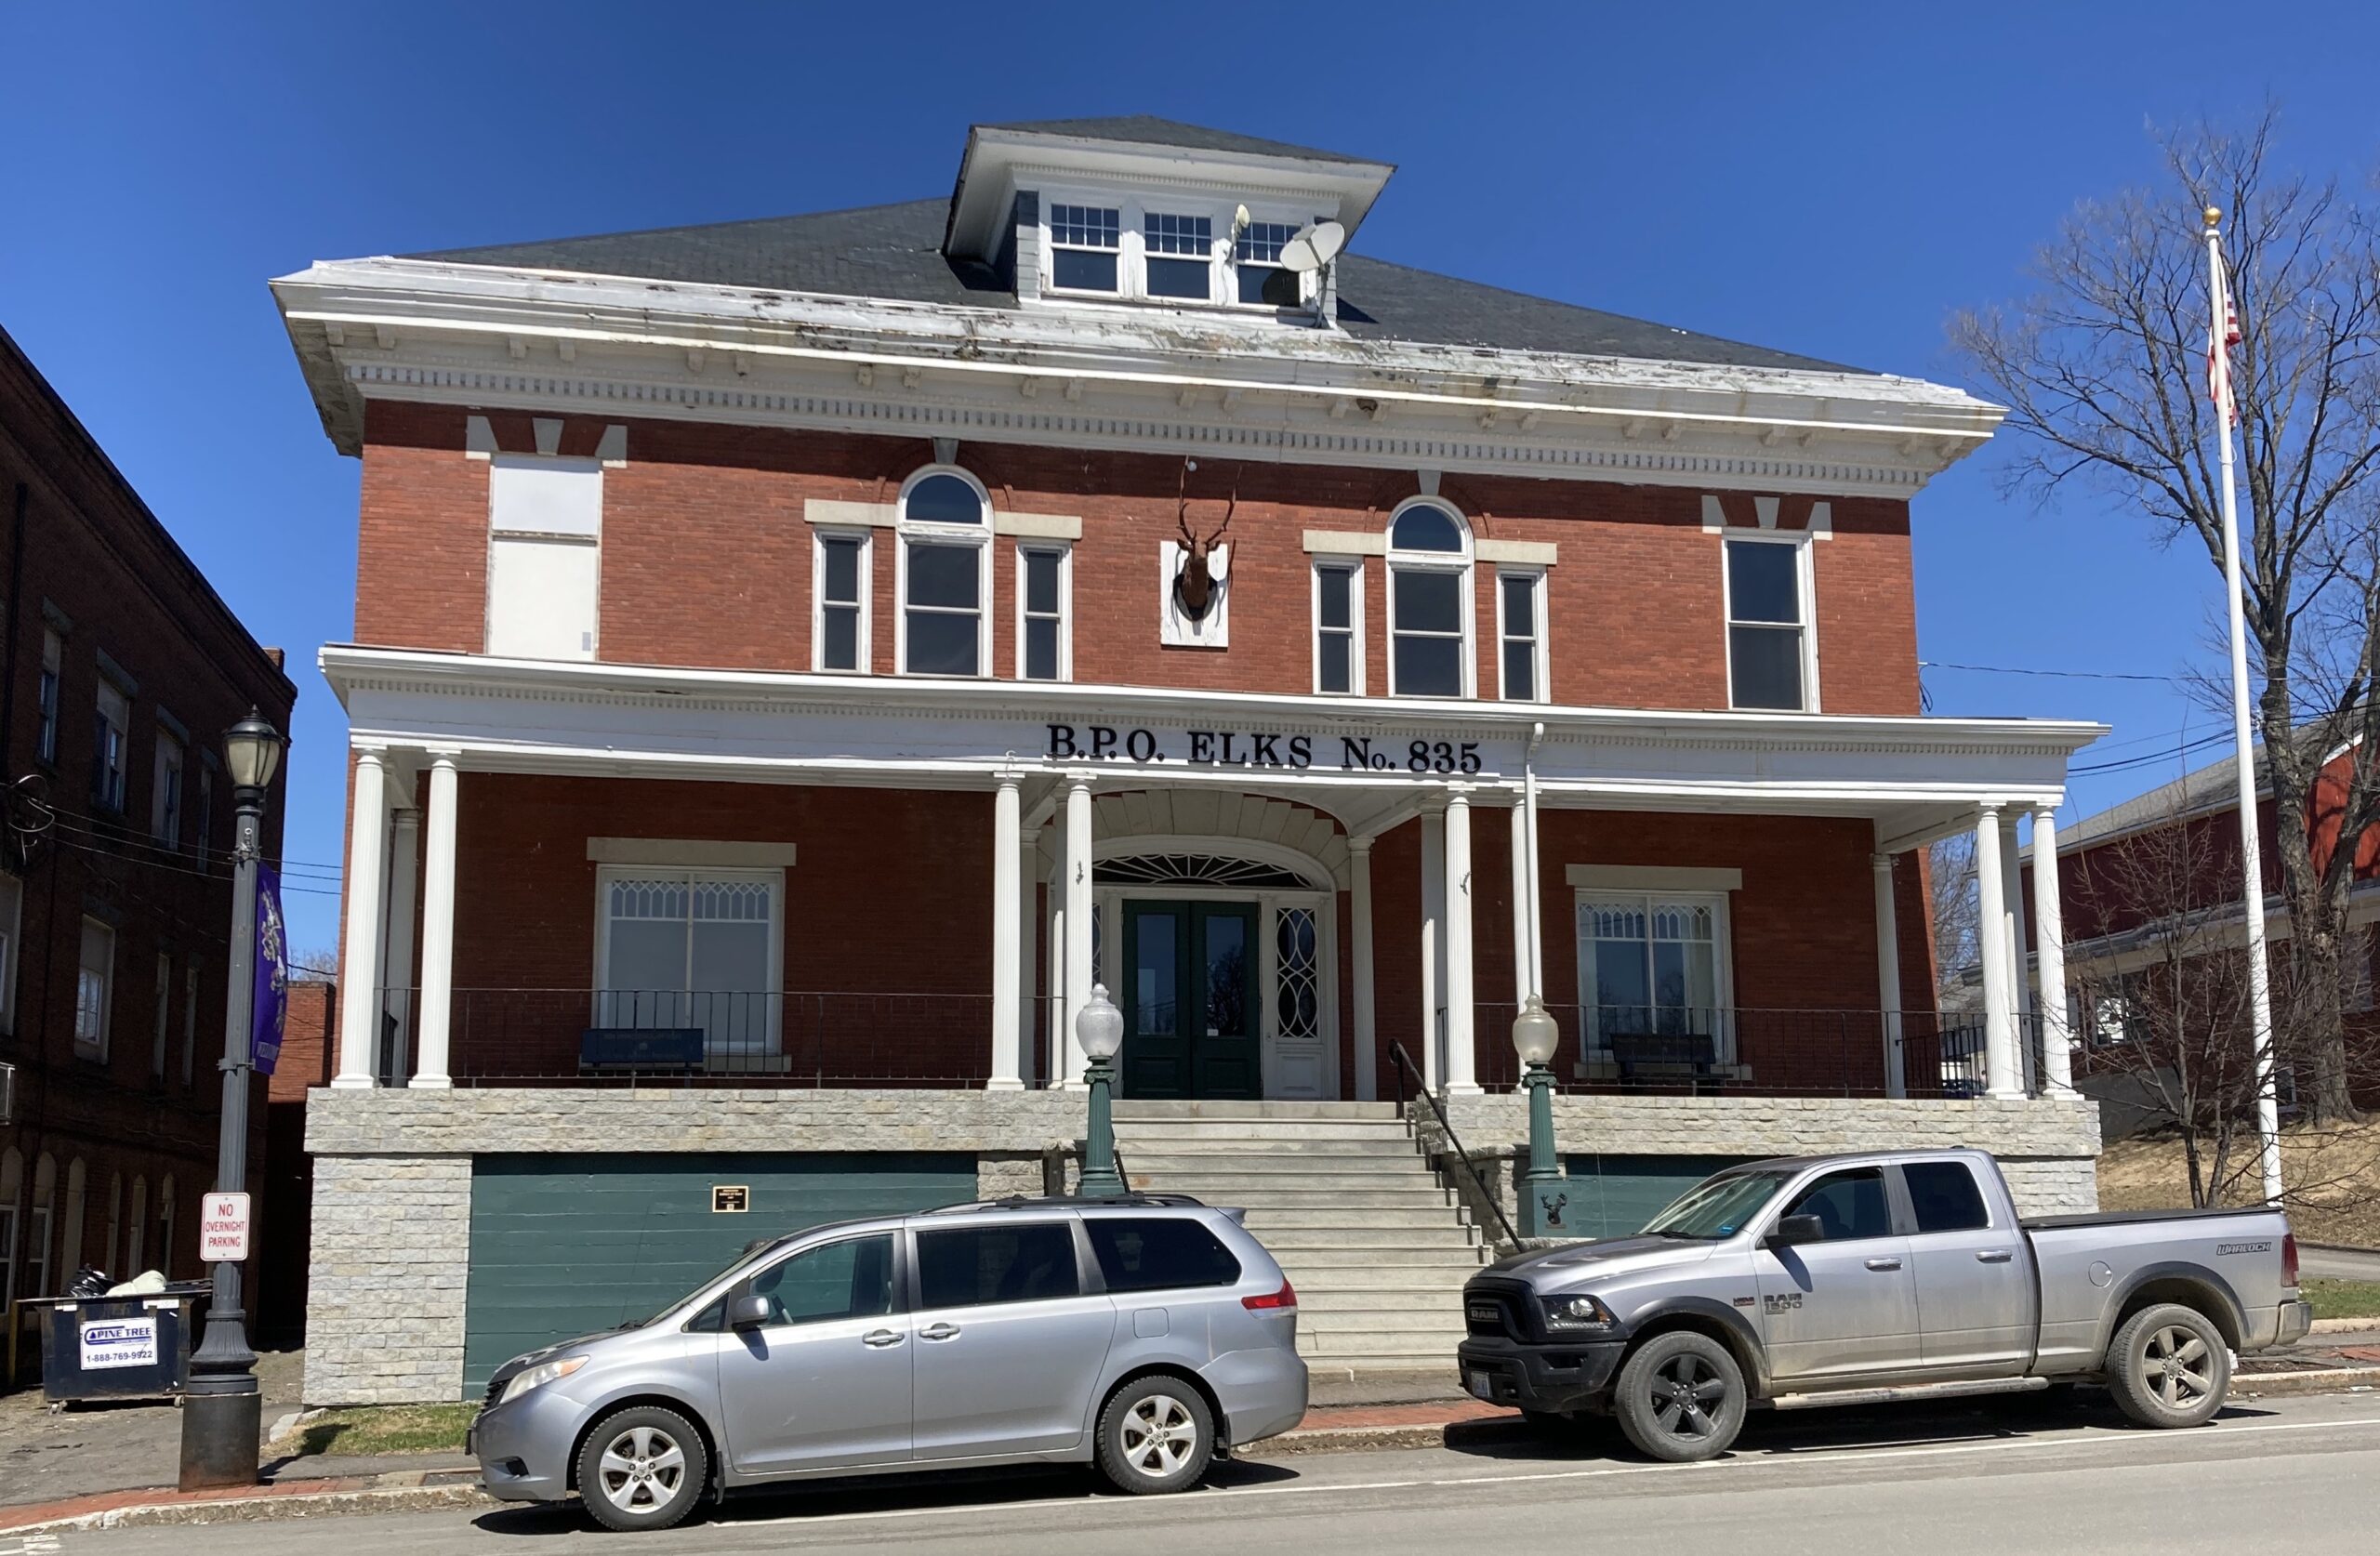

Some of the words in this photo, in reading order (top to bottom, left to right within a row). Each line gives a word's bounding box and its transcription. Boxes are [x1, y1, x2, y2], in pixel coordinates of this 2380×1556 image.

[1047, 724, 1165, 761] B.P.O.
[1187, 731, 1312, 769] ELKS
[1341, 737, 1396, 771] No.
[1408, 740, 1482, 774] 835
[218, 1204, 233, 1217] NO
[205, 1221, 245, 1232] OVERNIGHT
[208, 1236, 241, 1247] PARKING
[2216, 1242, 2271, 1256] WARLOCK
[1471, 1310, 1499, 1319] RAM
[96, 1328, 123, 1339] PINE
[126, 1327, 152, 1337] TREE
[86, 1351, 152, 1363] 1-888-769-9922
